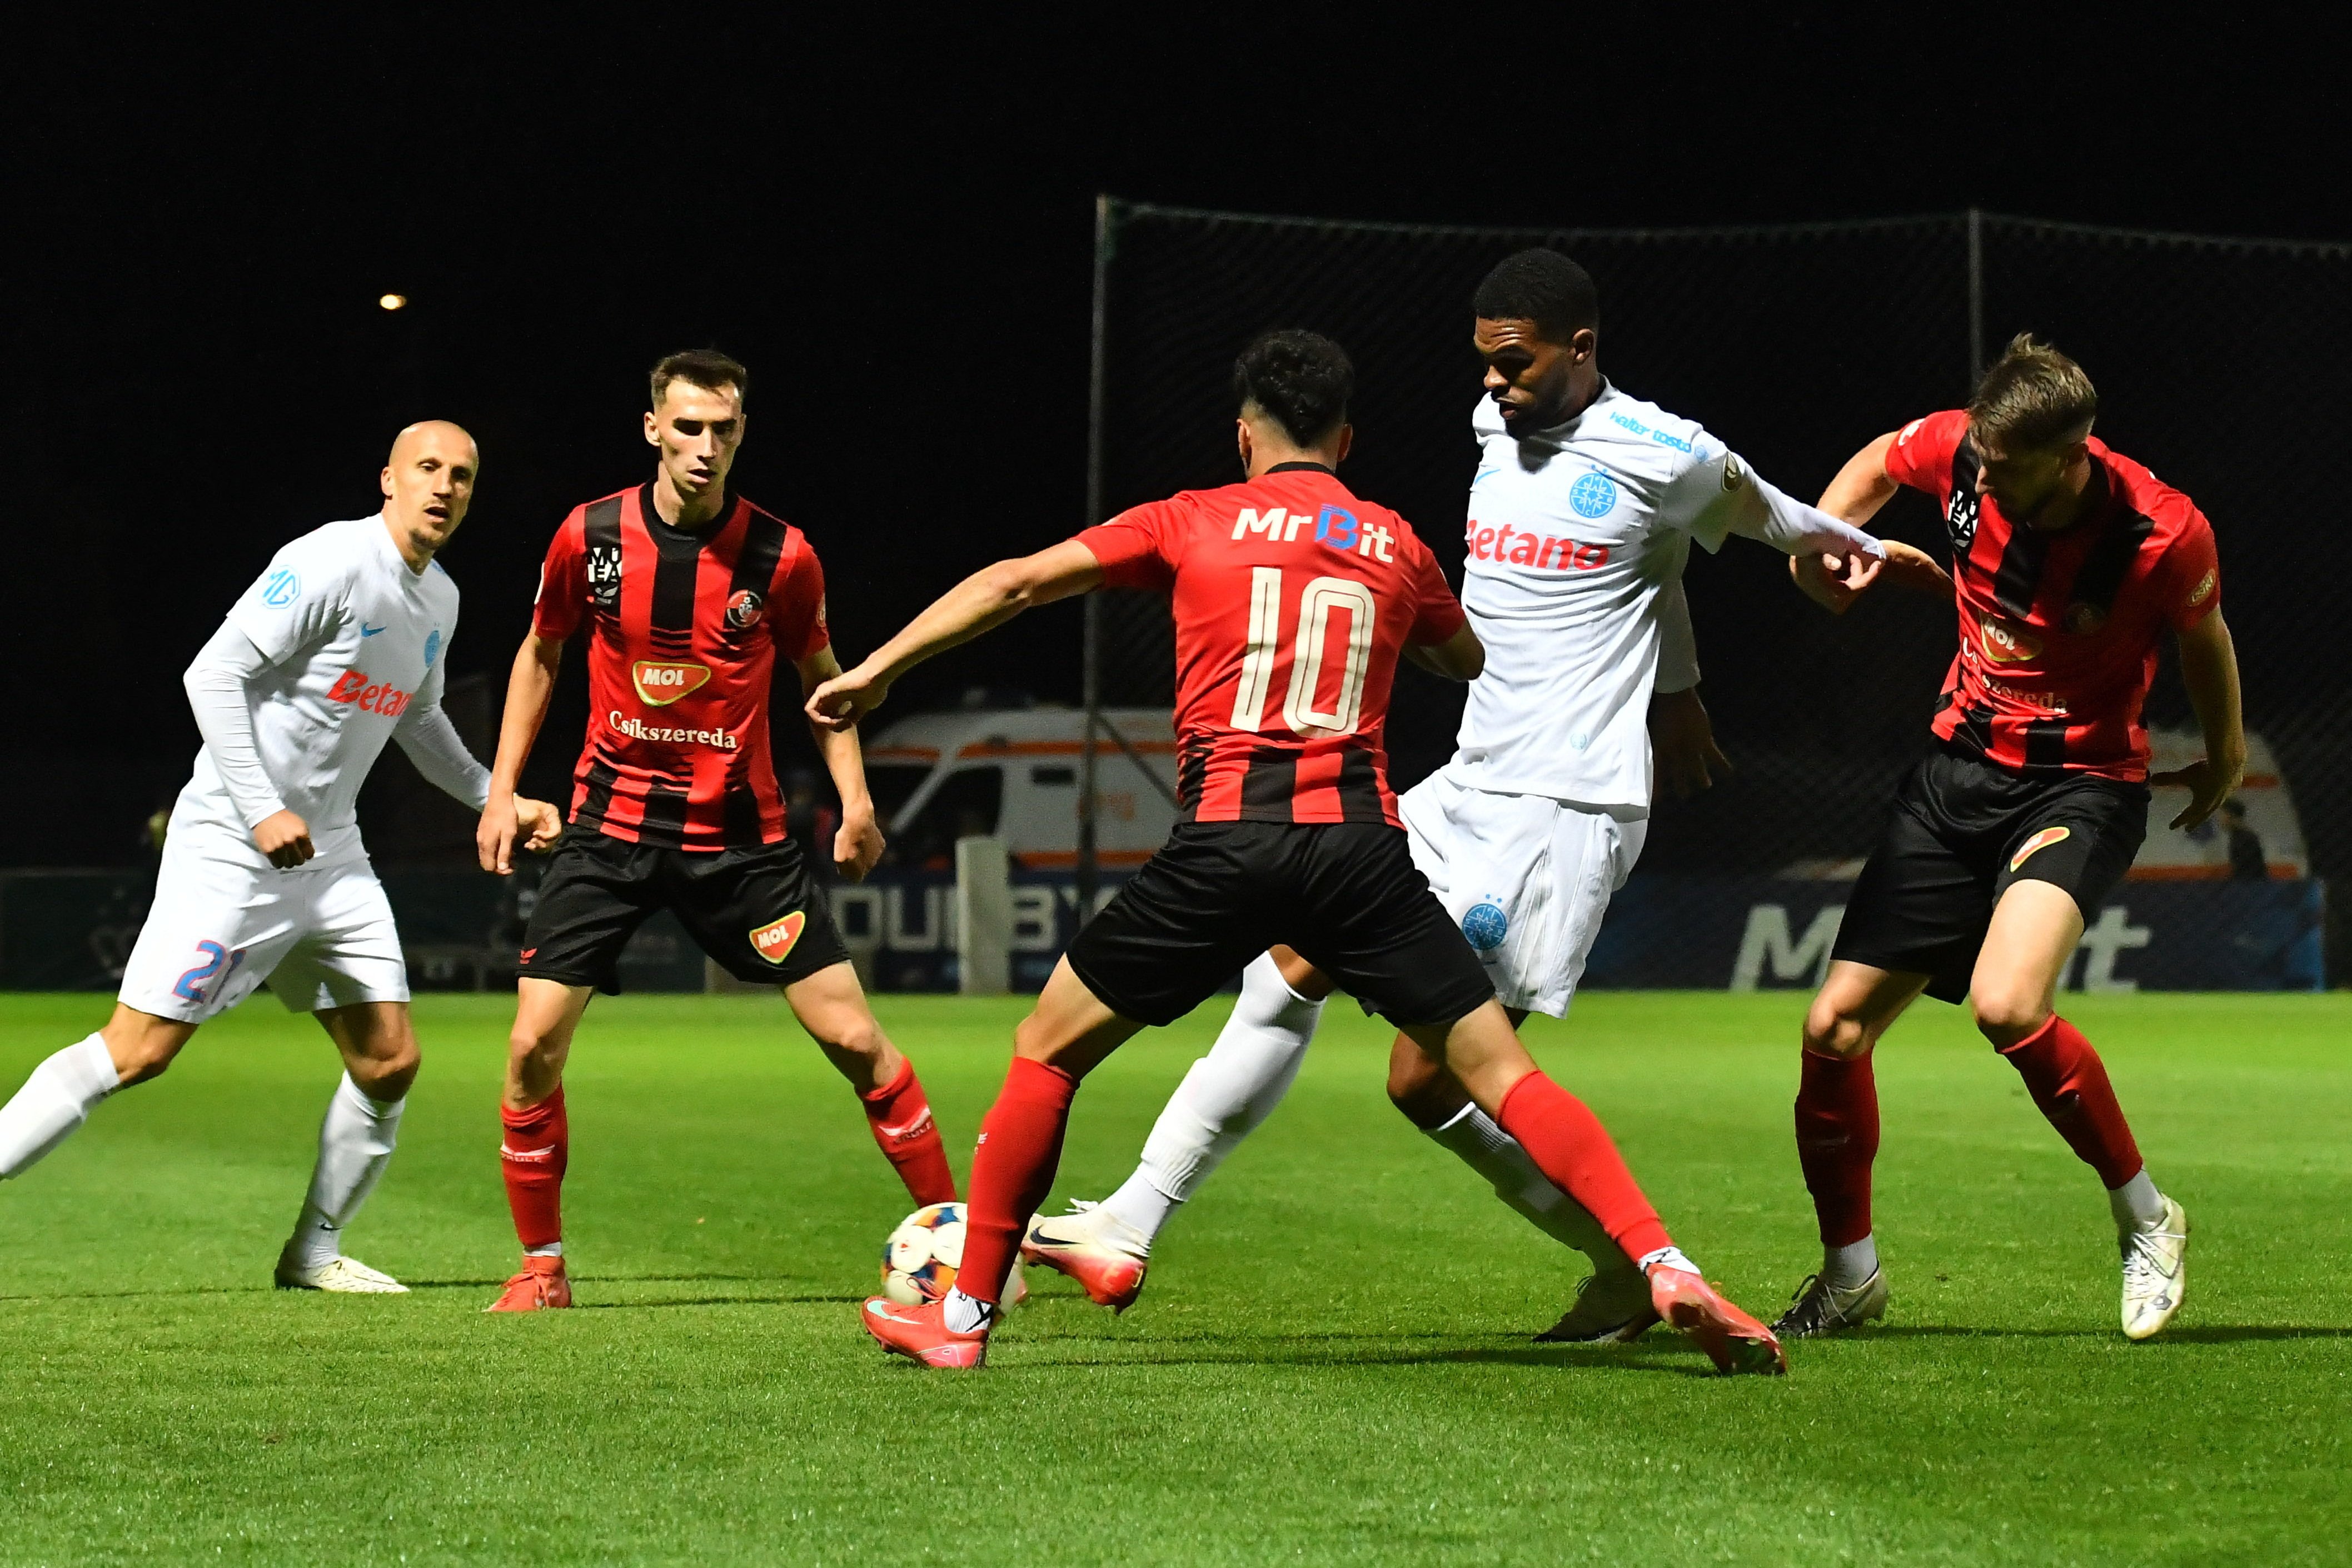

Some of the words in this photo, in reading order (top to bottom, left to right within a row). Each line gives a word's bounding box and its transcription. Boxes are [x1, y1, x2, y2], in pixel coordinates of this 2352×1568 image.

[1653, 430, 1692, 453] tosto
[263, 570, 296, 605] MG
[1230, 567, 1376, 739] 10
[642, 668, 685, 686] MOL
[609, 711, 737, 748] Csíkszereda
[757, 925, 789, 949] MOL
